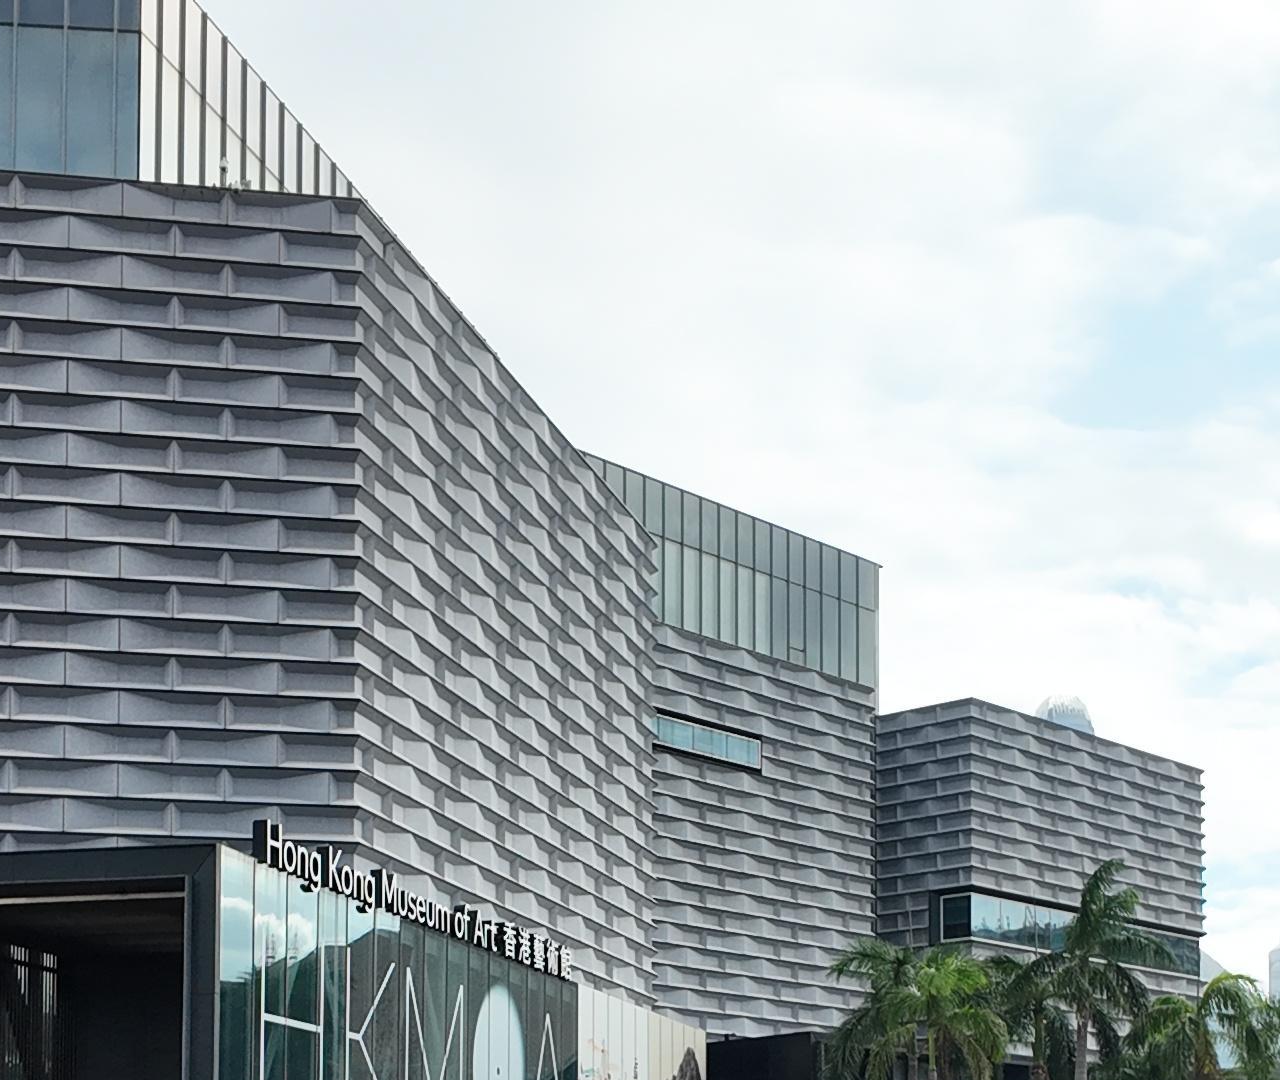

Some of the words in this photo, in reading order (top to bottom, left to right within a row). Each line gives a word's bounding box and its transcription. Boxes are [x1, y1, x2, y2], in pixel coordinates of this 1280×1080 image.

[265, 819, 322, 893] Hong
[326, 844, 376, 911] Kong
[380, 869, 452, 934] Museum
[454, 903, 471, 941] of
[473, 910, 499, 953] Art
[502, 921, 572, 982] 香港藝術館
